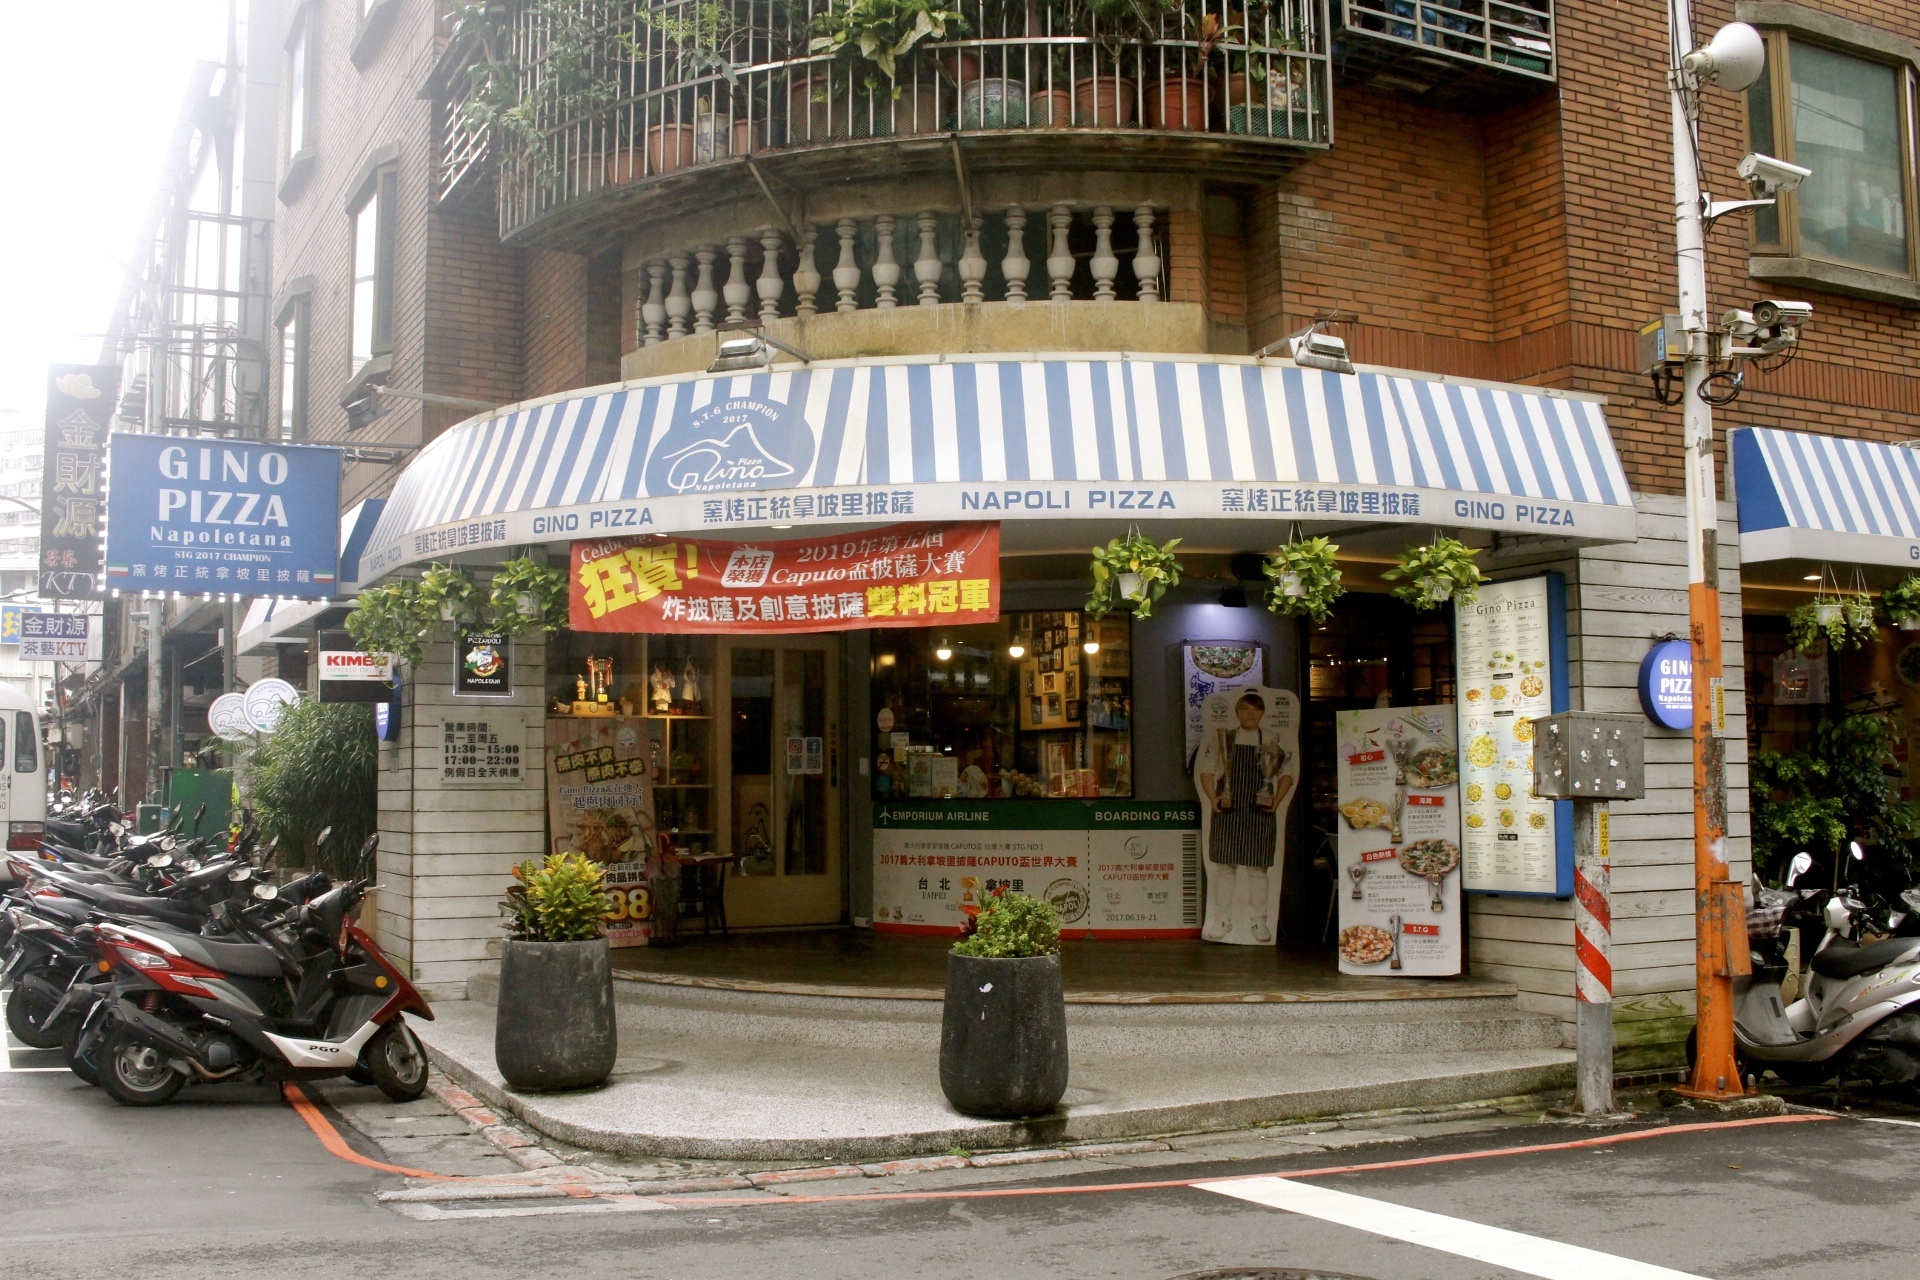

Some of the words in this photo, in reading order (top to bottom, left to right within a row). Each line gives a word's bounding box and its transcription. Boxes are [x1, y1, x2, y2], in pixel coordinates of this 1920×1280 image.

[692, 406, 721, 429] S.T.G
[725, 401, 780, 422] CHAMPION
[723, 415, 748, 424] 2017
[159, 446, 289, 485] GINO
[737, 457, 763, 465] Pizza
[53, 407, 101, 539] 金財源
[694, 482, 757, 492] Napoletana
[158, 488, 289, 528] PIZZA
[703, 491, 914, 523] 窯烤正統拿坡里披薩
[961, 490, 1069, 510] NAPOLI
[1088, 490, 1176, 510] PIZZA
[1222, 488, 1421, 516] 窯烤正統拿坡里披薩
[532, 513, 579, 534] GINO
[590, 507, 654, 529] PIZZA
[1454, 498, 1504, 521] GINO
[1516, 504, 1576, 527] PIZZA
[151, 526, 291, 547] Napoletana
[414, 519, 507, 555] 窯烤正統拿坡里披薩
[174, 550, 193, 560] STG
[195, 551, 221, 561] 2017
[223, 552, 272, 563] CHAMPION
[580, 534, 652, 564] Celebrte
[369, 556, 387, 573] NAPOLI
[387, 545, 402, 563] PIZZA
[733, 554, 770, 570] 本店
[771, 550, 966, 586] Caputo盃披薩大賽
[132, 563, 310, 583] 窯烤正統拿坡里披薩
[578, 543, 699, 620] 狂賀!
[726, 569, 763, 584] 榮獲
[41, 571, 98, 599] KTV
[1476, 603, 1502, 615] Gino
[1506, 600, 1536, 611] Pizza
[24, 616, 86, 636] 金財源
[1660, 659, 1692, 675] GIN
[444, 722, 492, 733] 營業時間:
[444, 733, 499, 744] 周一至周五
[444, 744, 520, 754] 11:30~15:00
[444, 755, 520, 765] 17:00~22:00
[444, 767, 520, 778] 例假日全天供應
[892, 811, 943, 821] EMPORIUM
[946, 811, 990, 821] AIRLINE
[1095, 811, 1160, 821] BOARDING
[1164, 811, 1195, 821] PASS
[921, 891, 947, 900] TAIPEI
[1412, 925, 1429, 933] S.T.G
[309, 1044, 340, 1054] PGO
